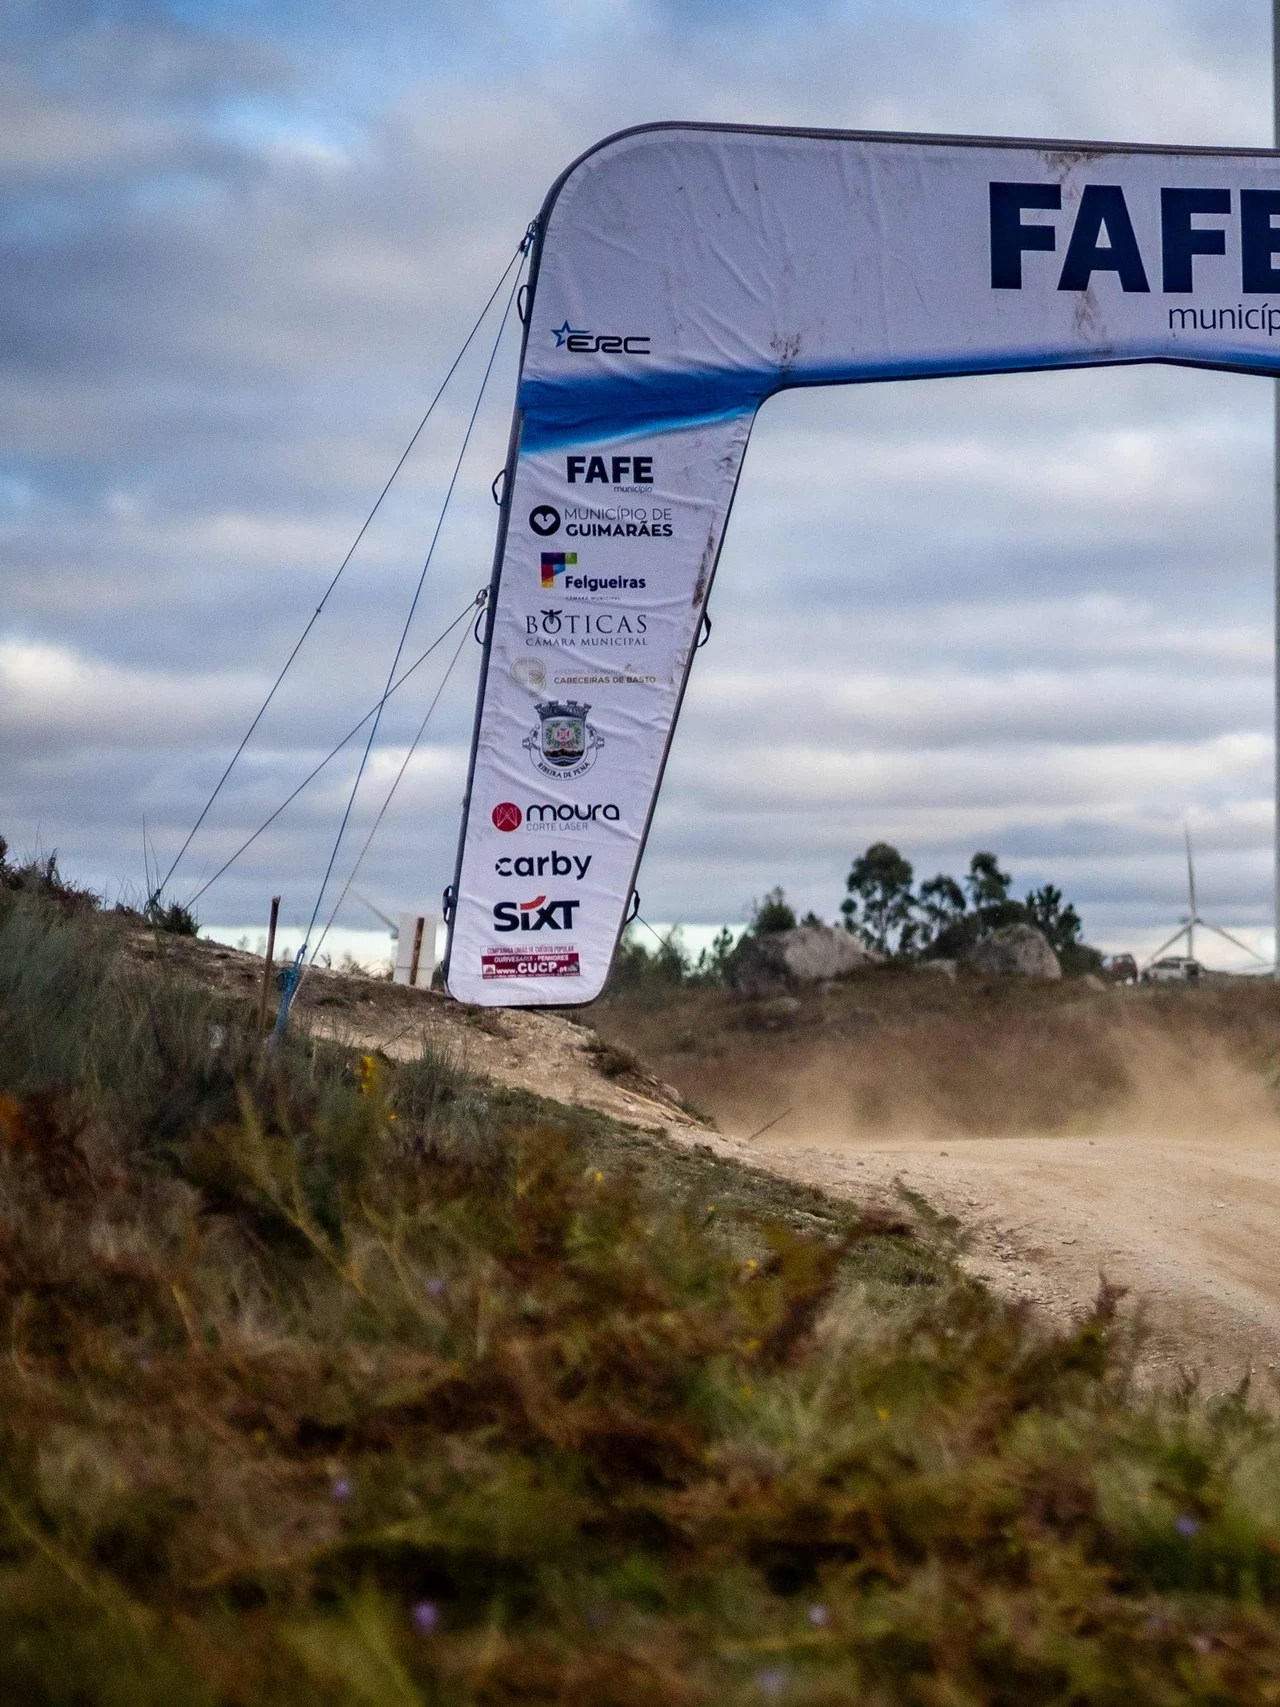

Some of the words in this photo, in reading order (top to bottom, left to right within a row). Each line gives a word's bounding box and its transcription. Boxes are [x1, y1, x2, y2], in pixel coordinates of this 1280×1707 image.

[567, 335, 651, 354] ERC
[566, 456, 654, 484] FAFE
[564, 506, 647, 522] MUNICÍPIO
[652, 508, 673, 521] DE
[565, 520, 674, 537] GUIMARÃES
[565, 575, 646, 591] Felgueiras
[526, 610, 647, 635] BOTICAS
[525, 637, 576, 647] CÂMARA
[580, 637, 648, 647] MUNICIPAL
[553, 676, 610, 685] CABECEIRAS
[612, 676, 624, 684] DE
[626, 675, 657, 684] BASTO
[537, 761, 562, 779] RIBEIRA
[573, 761, 591, 776] PENA
[526, 803, 621, 822] moura
[526, 822, 556, 832] CORTE
[559, 821, 589, 831] LASER
[495, 850, 593, 881] carby
[496, 962, 567, 976] www.CUCP.pt
